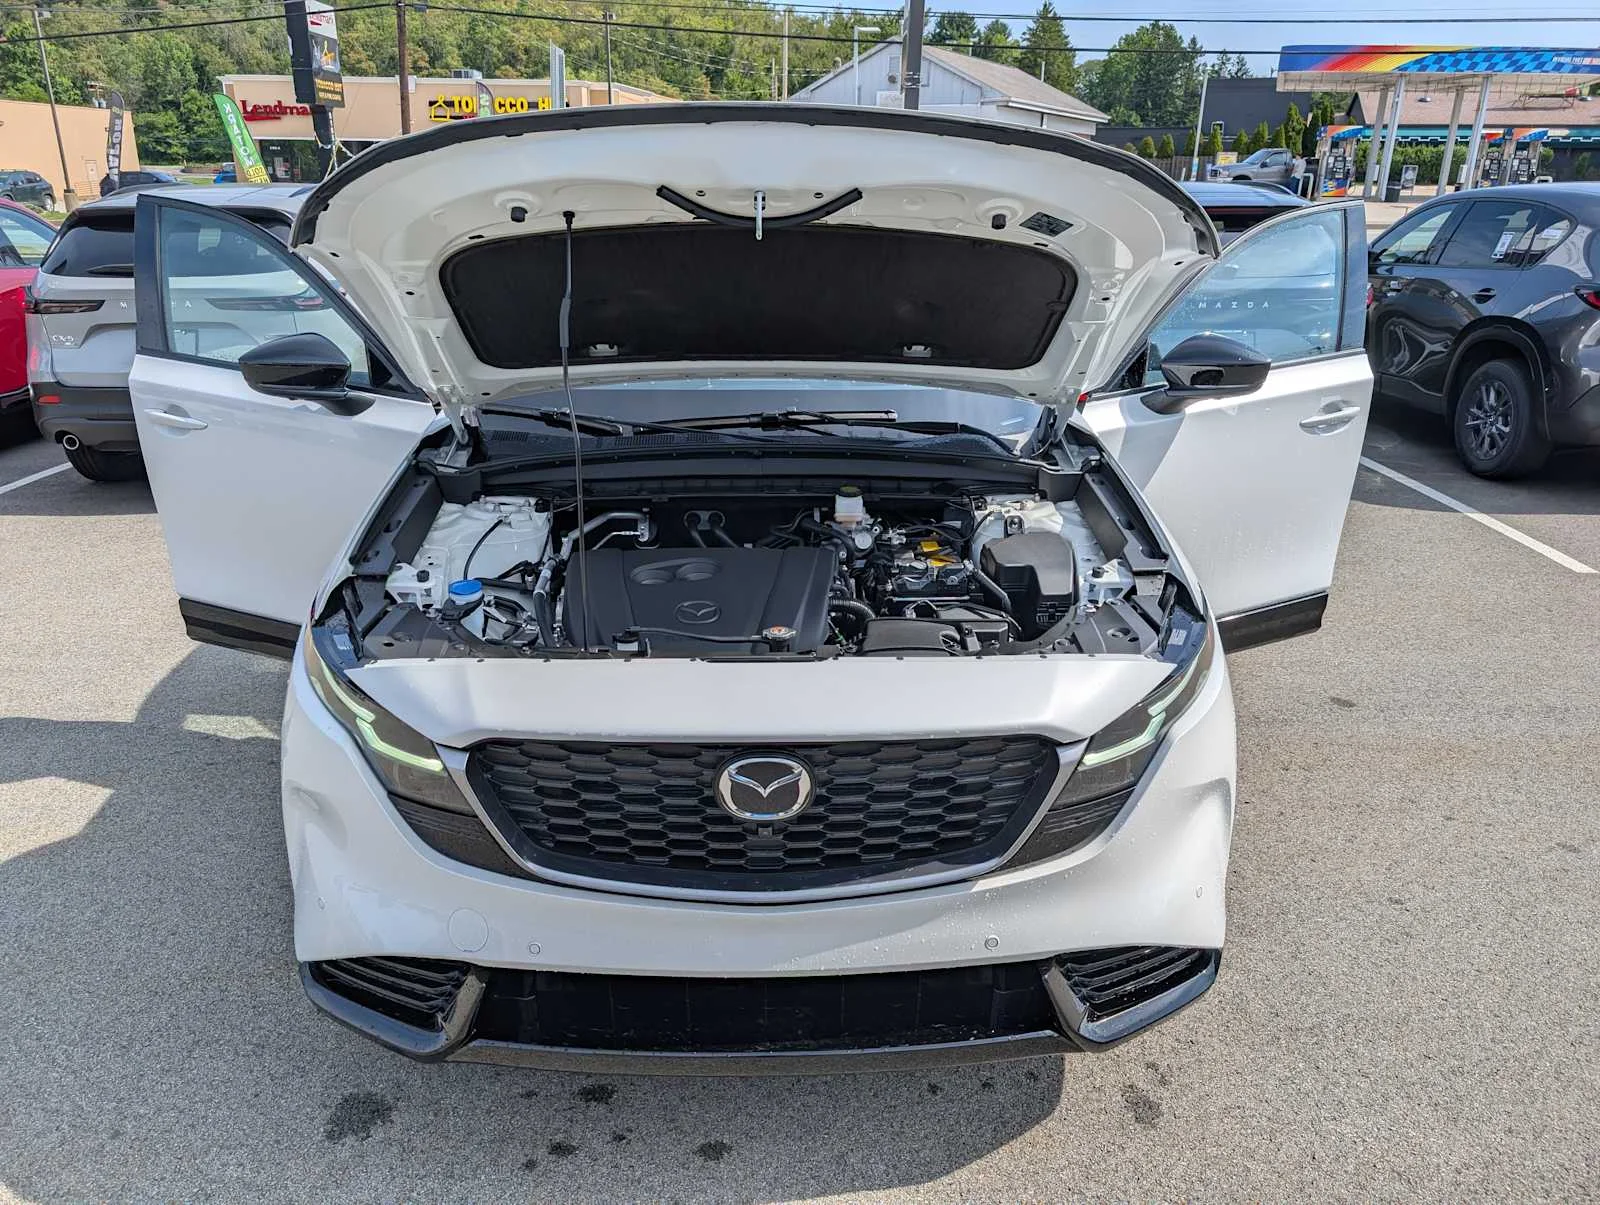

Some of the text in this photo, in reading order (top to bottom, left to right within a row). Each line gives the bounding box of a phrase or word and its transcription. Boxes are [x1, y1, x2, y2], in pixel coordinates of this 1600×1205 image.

[240, 99, 311, 116] Lendma
[450, 96, 529, 113] TOCCO
[1198, 301, 1269, 309] MAZDA
